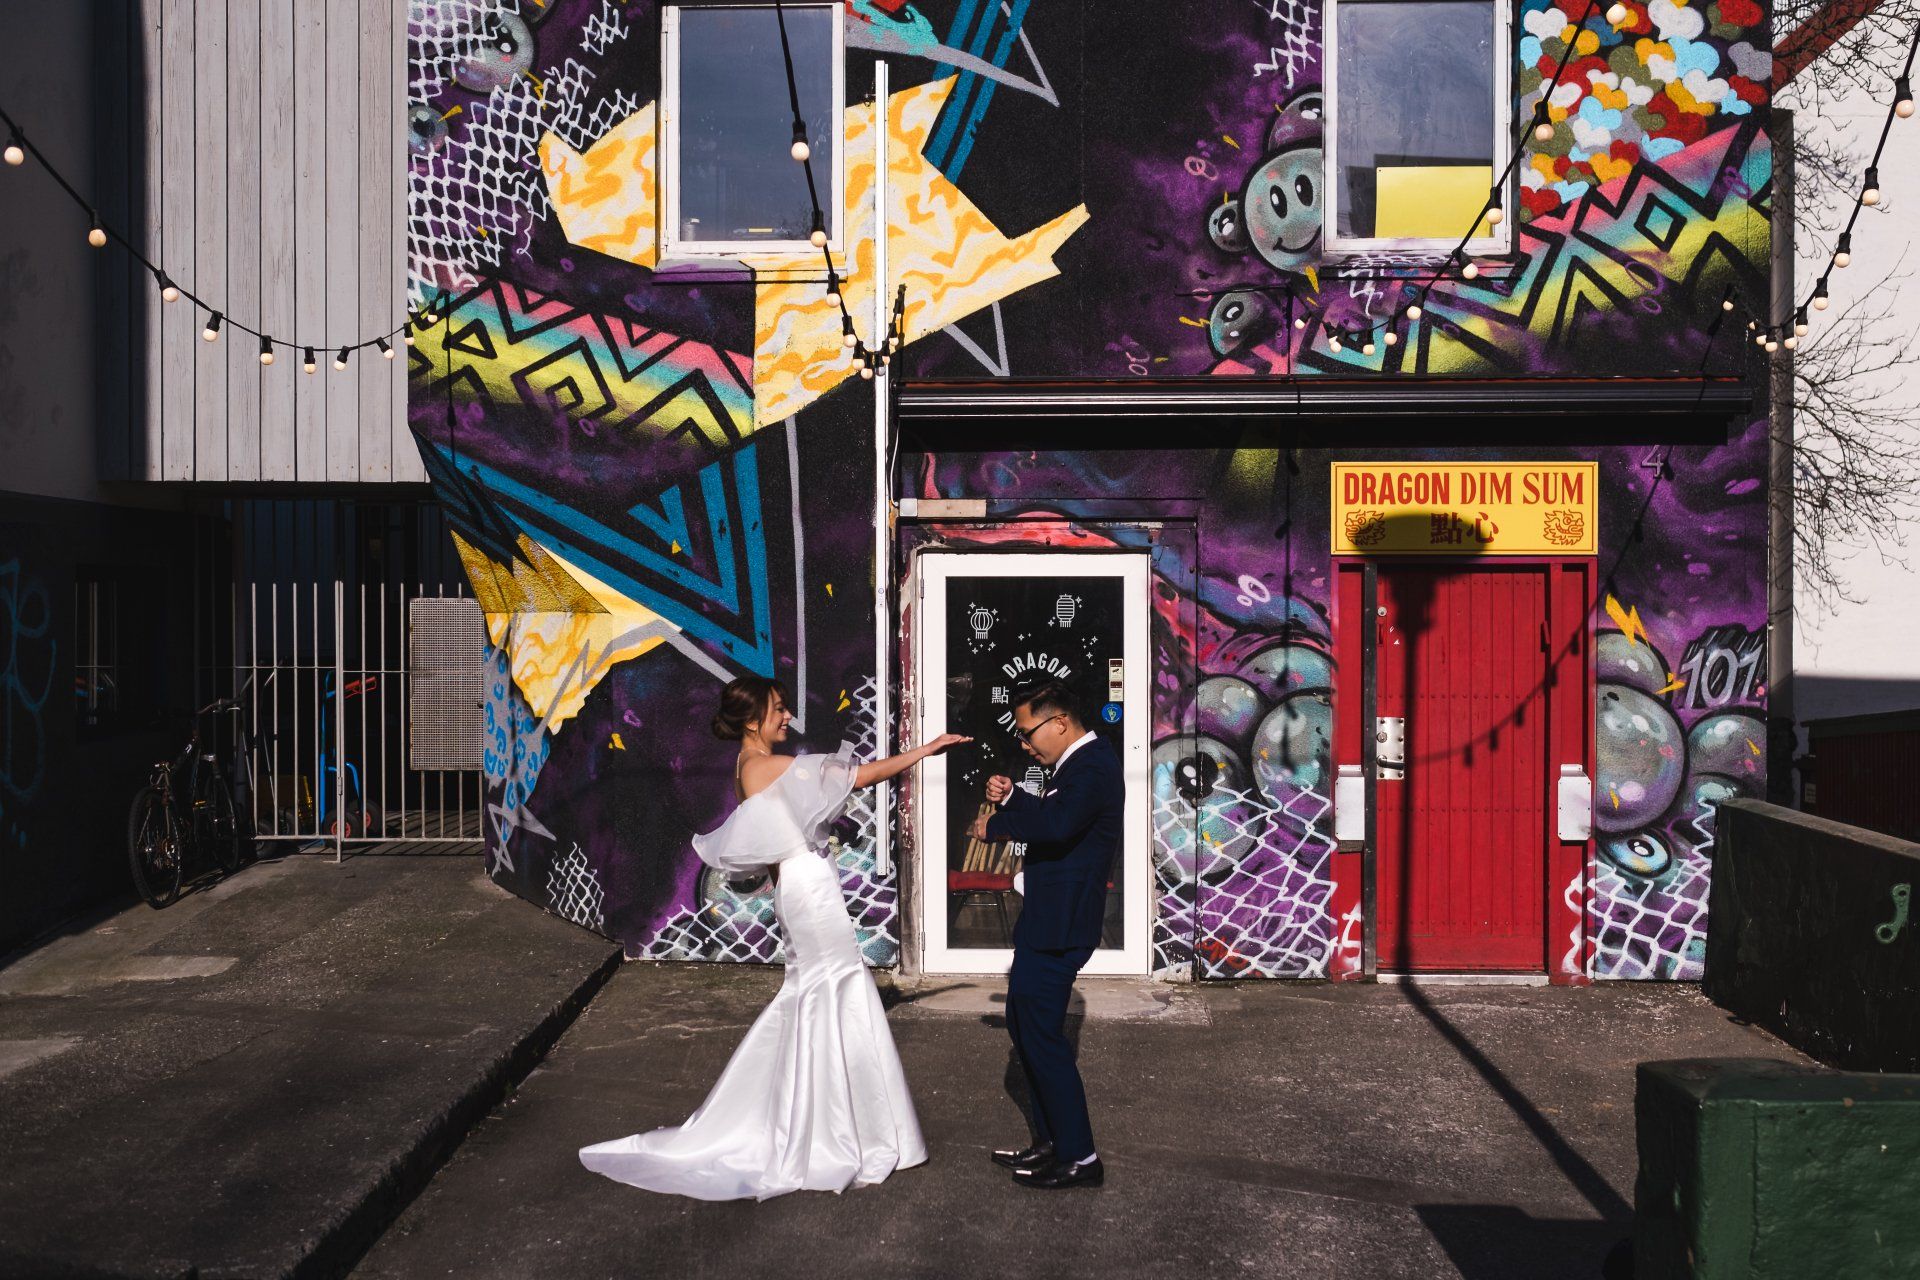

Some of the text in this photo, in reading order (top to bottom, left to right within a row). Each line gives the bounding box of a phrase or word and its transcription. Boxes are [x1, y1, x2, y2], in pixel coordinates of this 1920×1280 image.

[1344, 472, 1584, 505] DRAGON DIM SUM
[1430, 511, 1499, 545] 點心
[1002, 652, 1072, 680] DRAGON
[1680, 643, 1764, 709] 101
[997, 710, 1019, 737] DI
